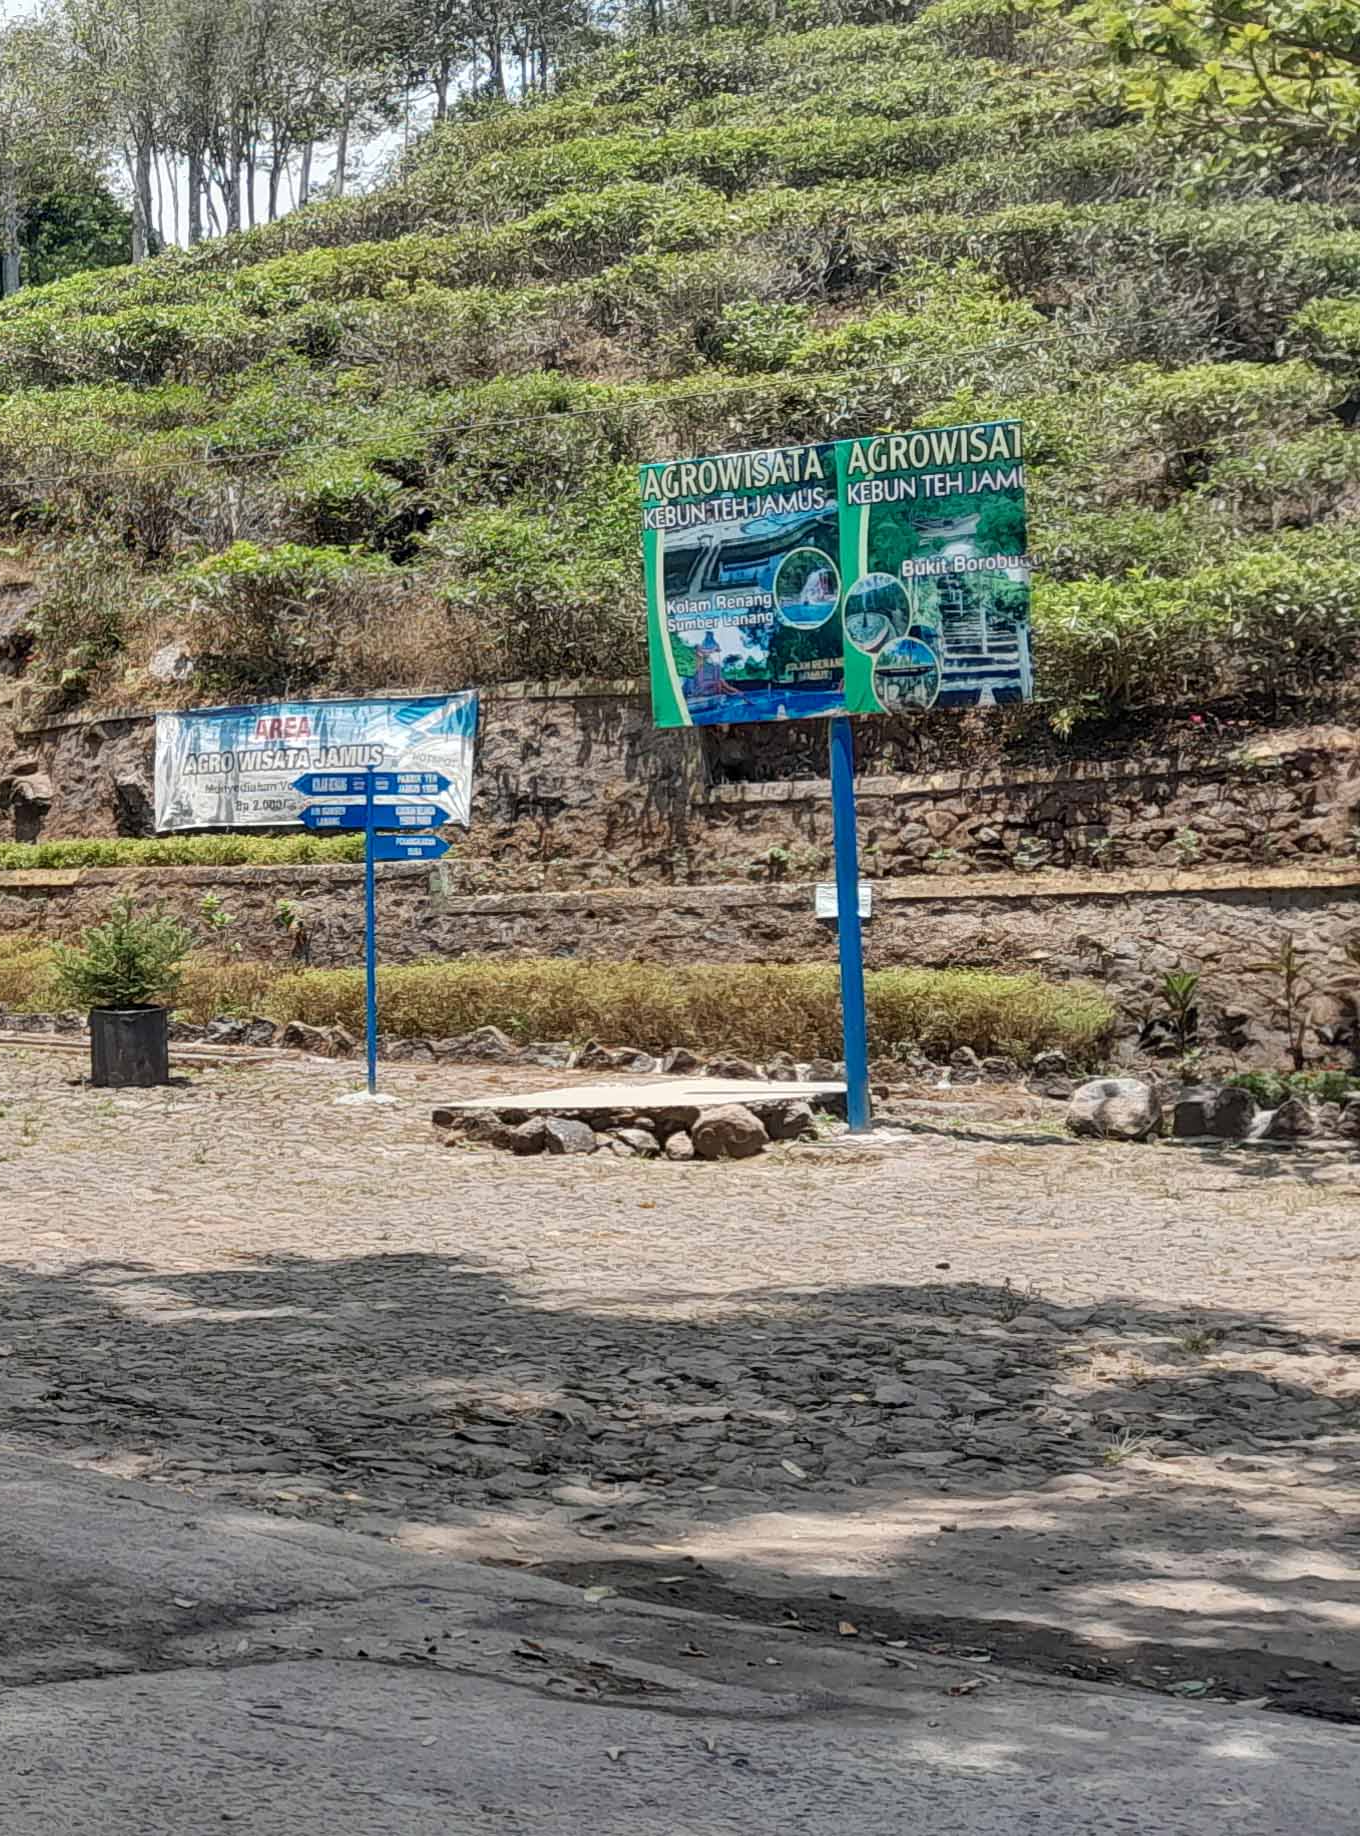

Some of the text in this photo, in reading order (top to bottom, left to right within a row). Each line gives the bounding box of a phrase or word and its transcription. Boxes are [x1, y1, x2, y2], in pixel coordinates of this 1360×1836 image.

[643, 448, 824, 500] AGROWISATA
[847, 476, 916, 504] KEBUN
[920, 471, 963, 497] TEH
[643, 487, 825, 529] KEBUN TEH JAMUS
[901, 559, 948, 577] Bukit
[666, 593, 773, 615] Kolam Renang
[667, 610, 774, 632] Sumber Lanang
[254, 716, 312, 740] AREA
[182, 744, 384, 776] AGRO WISATA JAMUS
